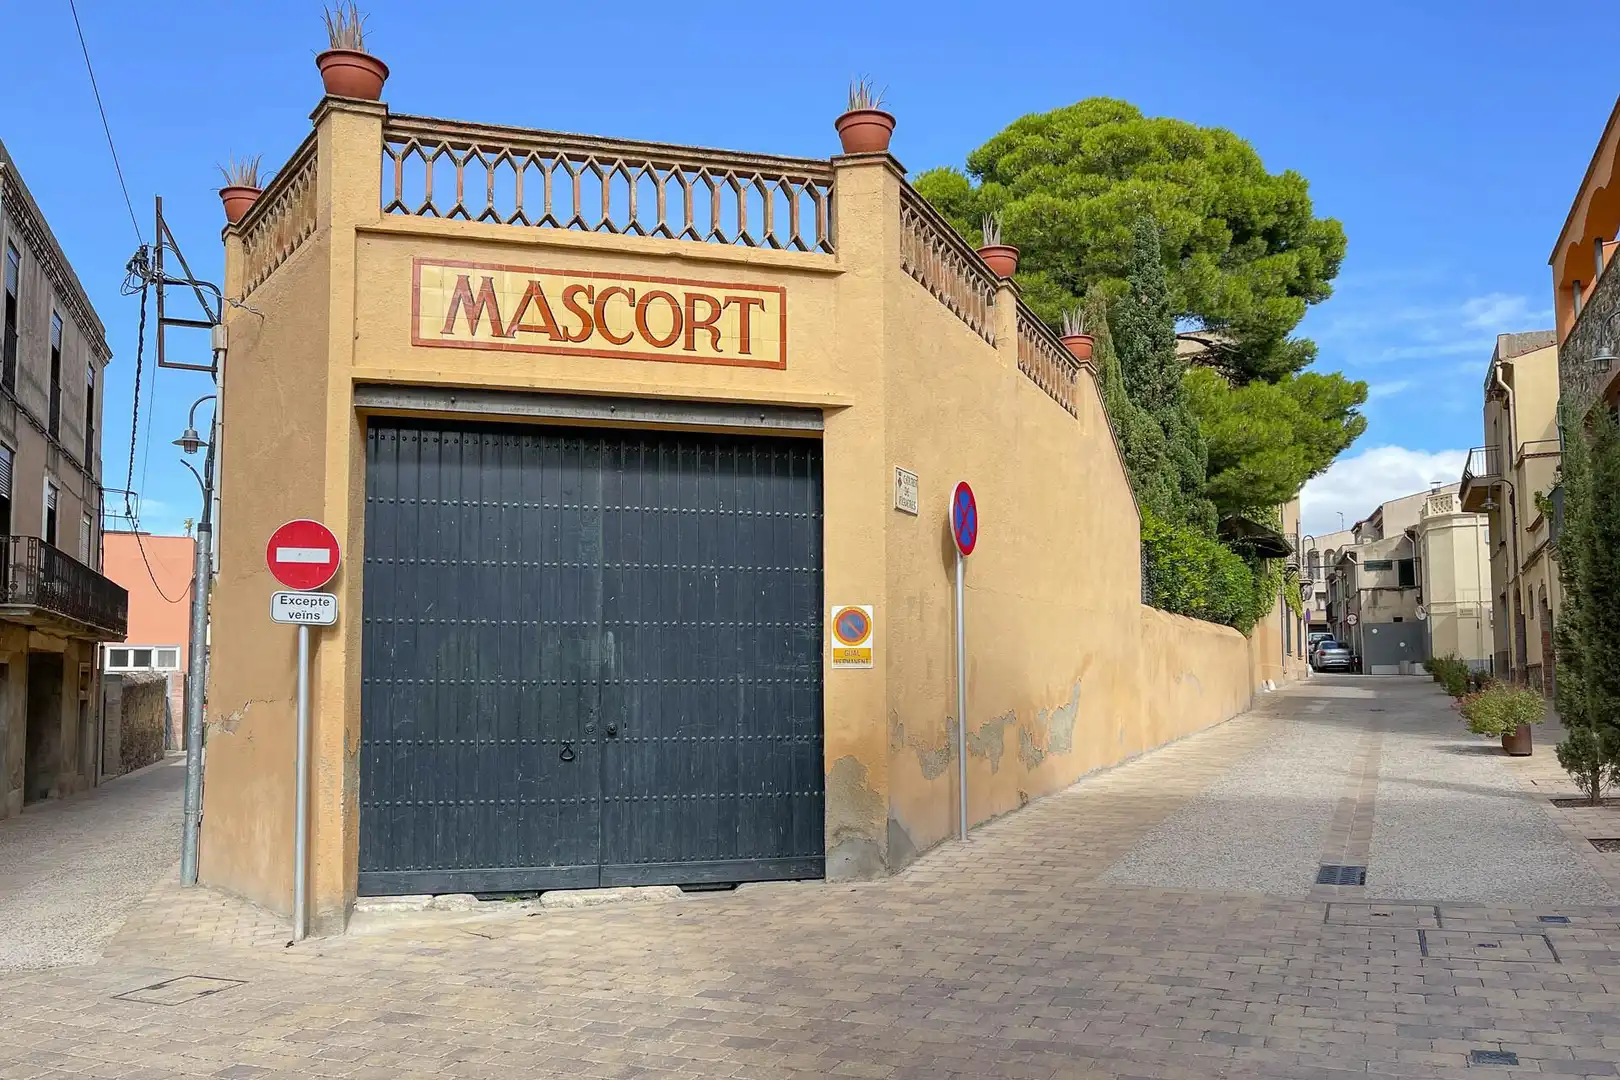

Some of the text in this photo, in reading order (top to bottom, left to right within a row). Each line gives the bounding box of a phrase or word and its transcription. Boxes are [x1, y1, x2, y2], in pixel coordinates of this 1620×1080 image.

[440, 274, 766, 354] MASCORT
[280, 595, 330, 608] Excepte
[288, 609, 321, 621] veïns
